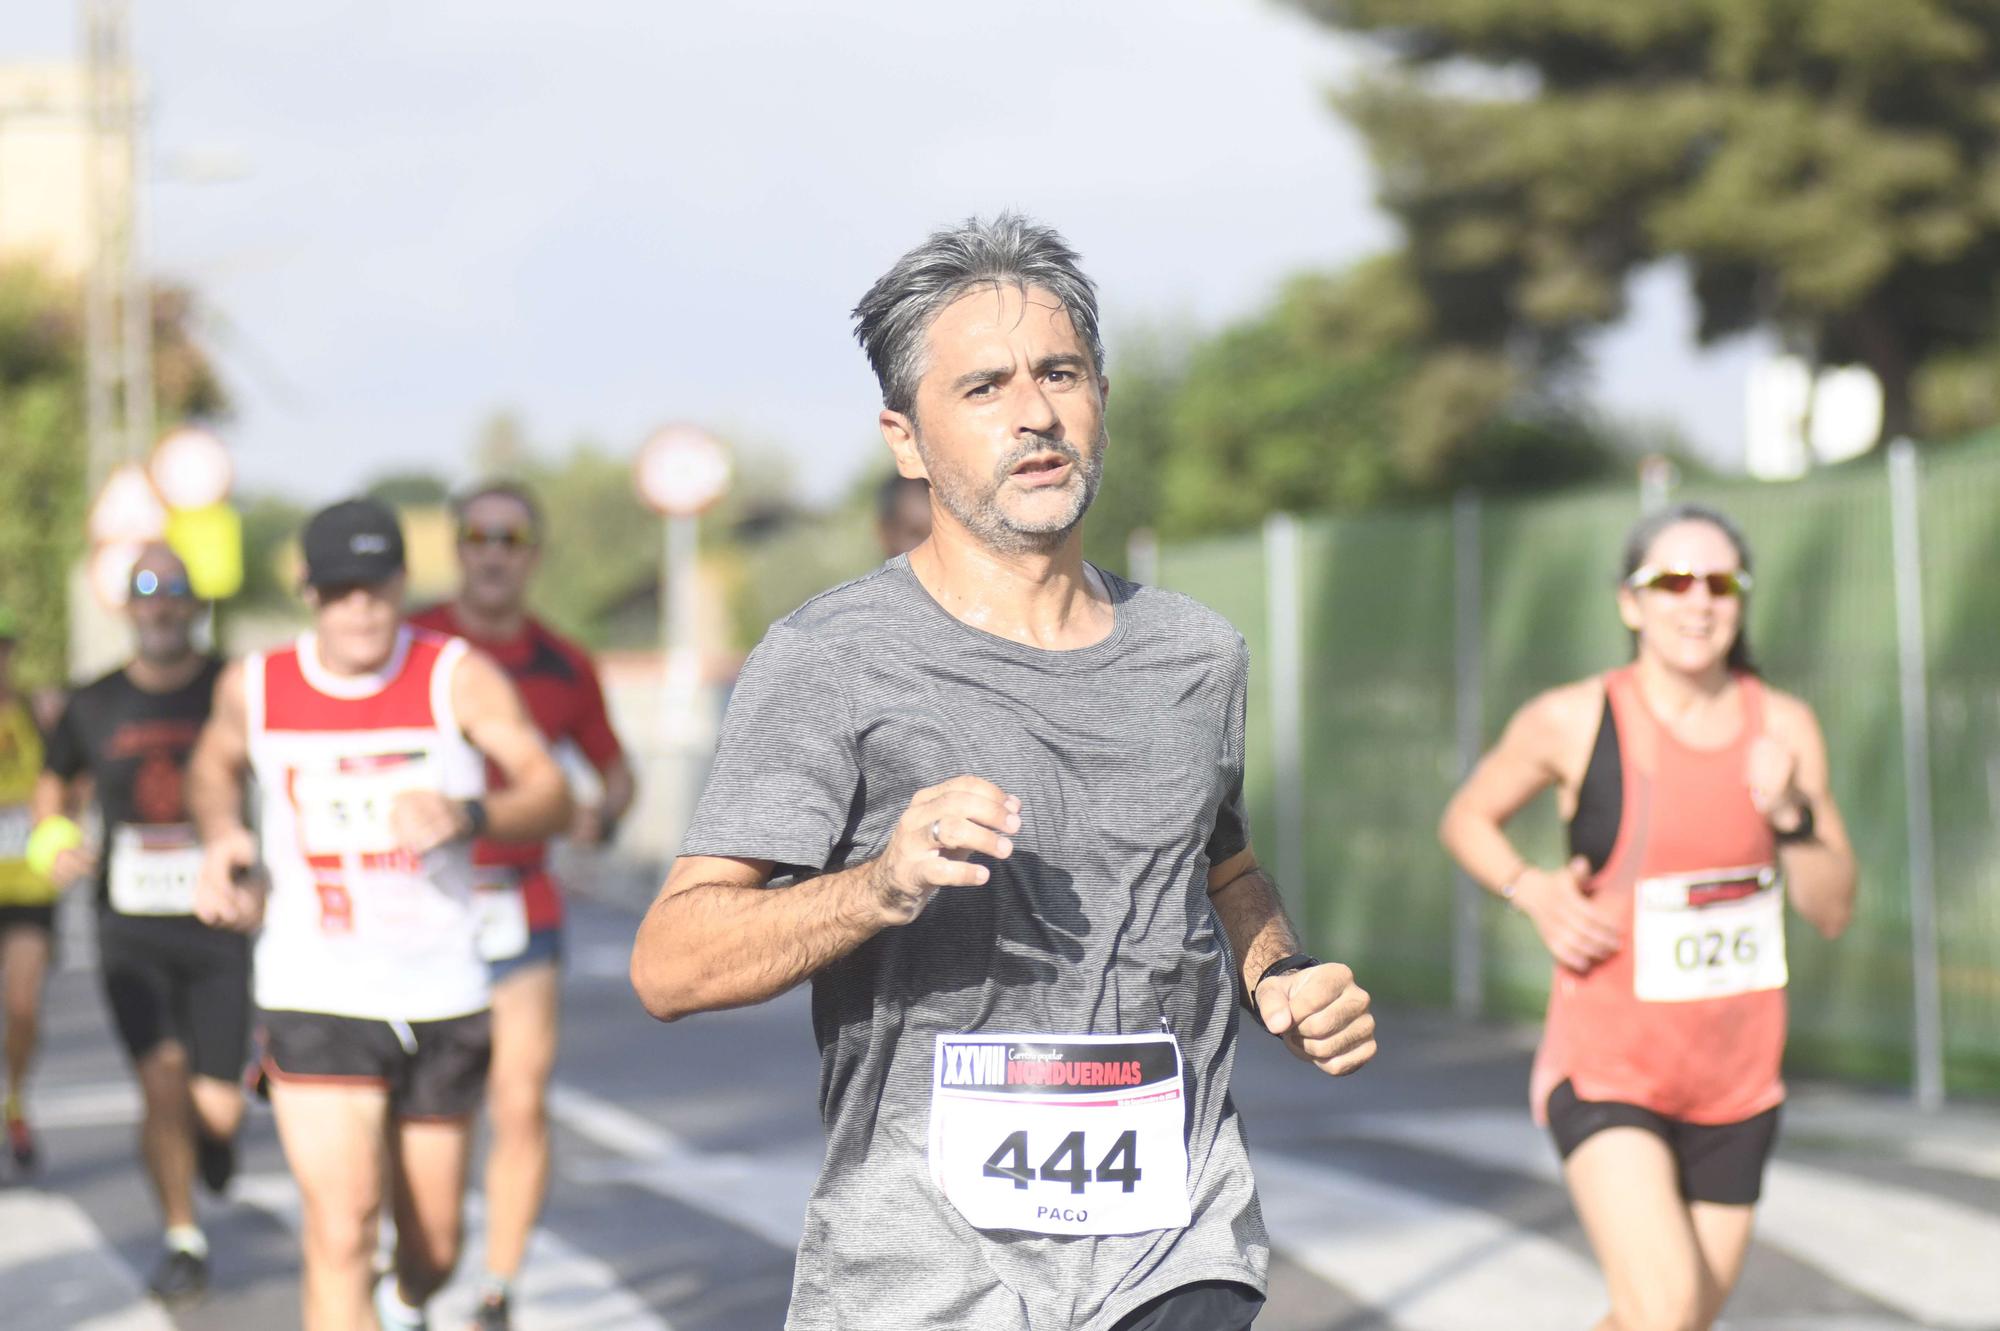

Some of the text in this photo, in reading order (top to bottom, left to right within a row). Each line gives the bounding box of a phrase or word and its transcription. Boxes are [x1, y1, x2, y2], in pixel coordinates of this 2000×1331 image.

[1675, 926, 1758, 971] 026
[943, 1045, 1006, 1085] XXVIII
[1007, 1060, 1142, 1086] NONDUERMAS
[983, 1130, 1142, 1194] 444
[1037, 1206, 1088, 1223] PACO
